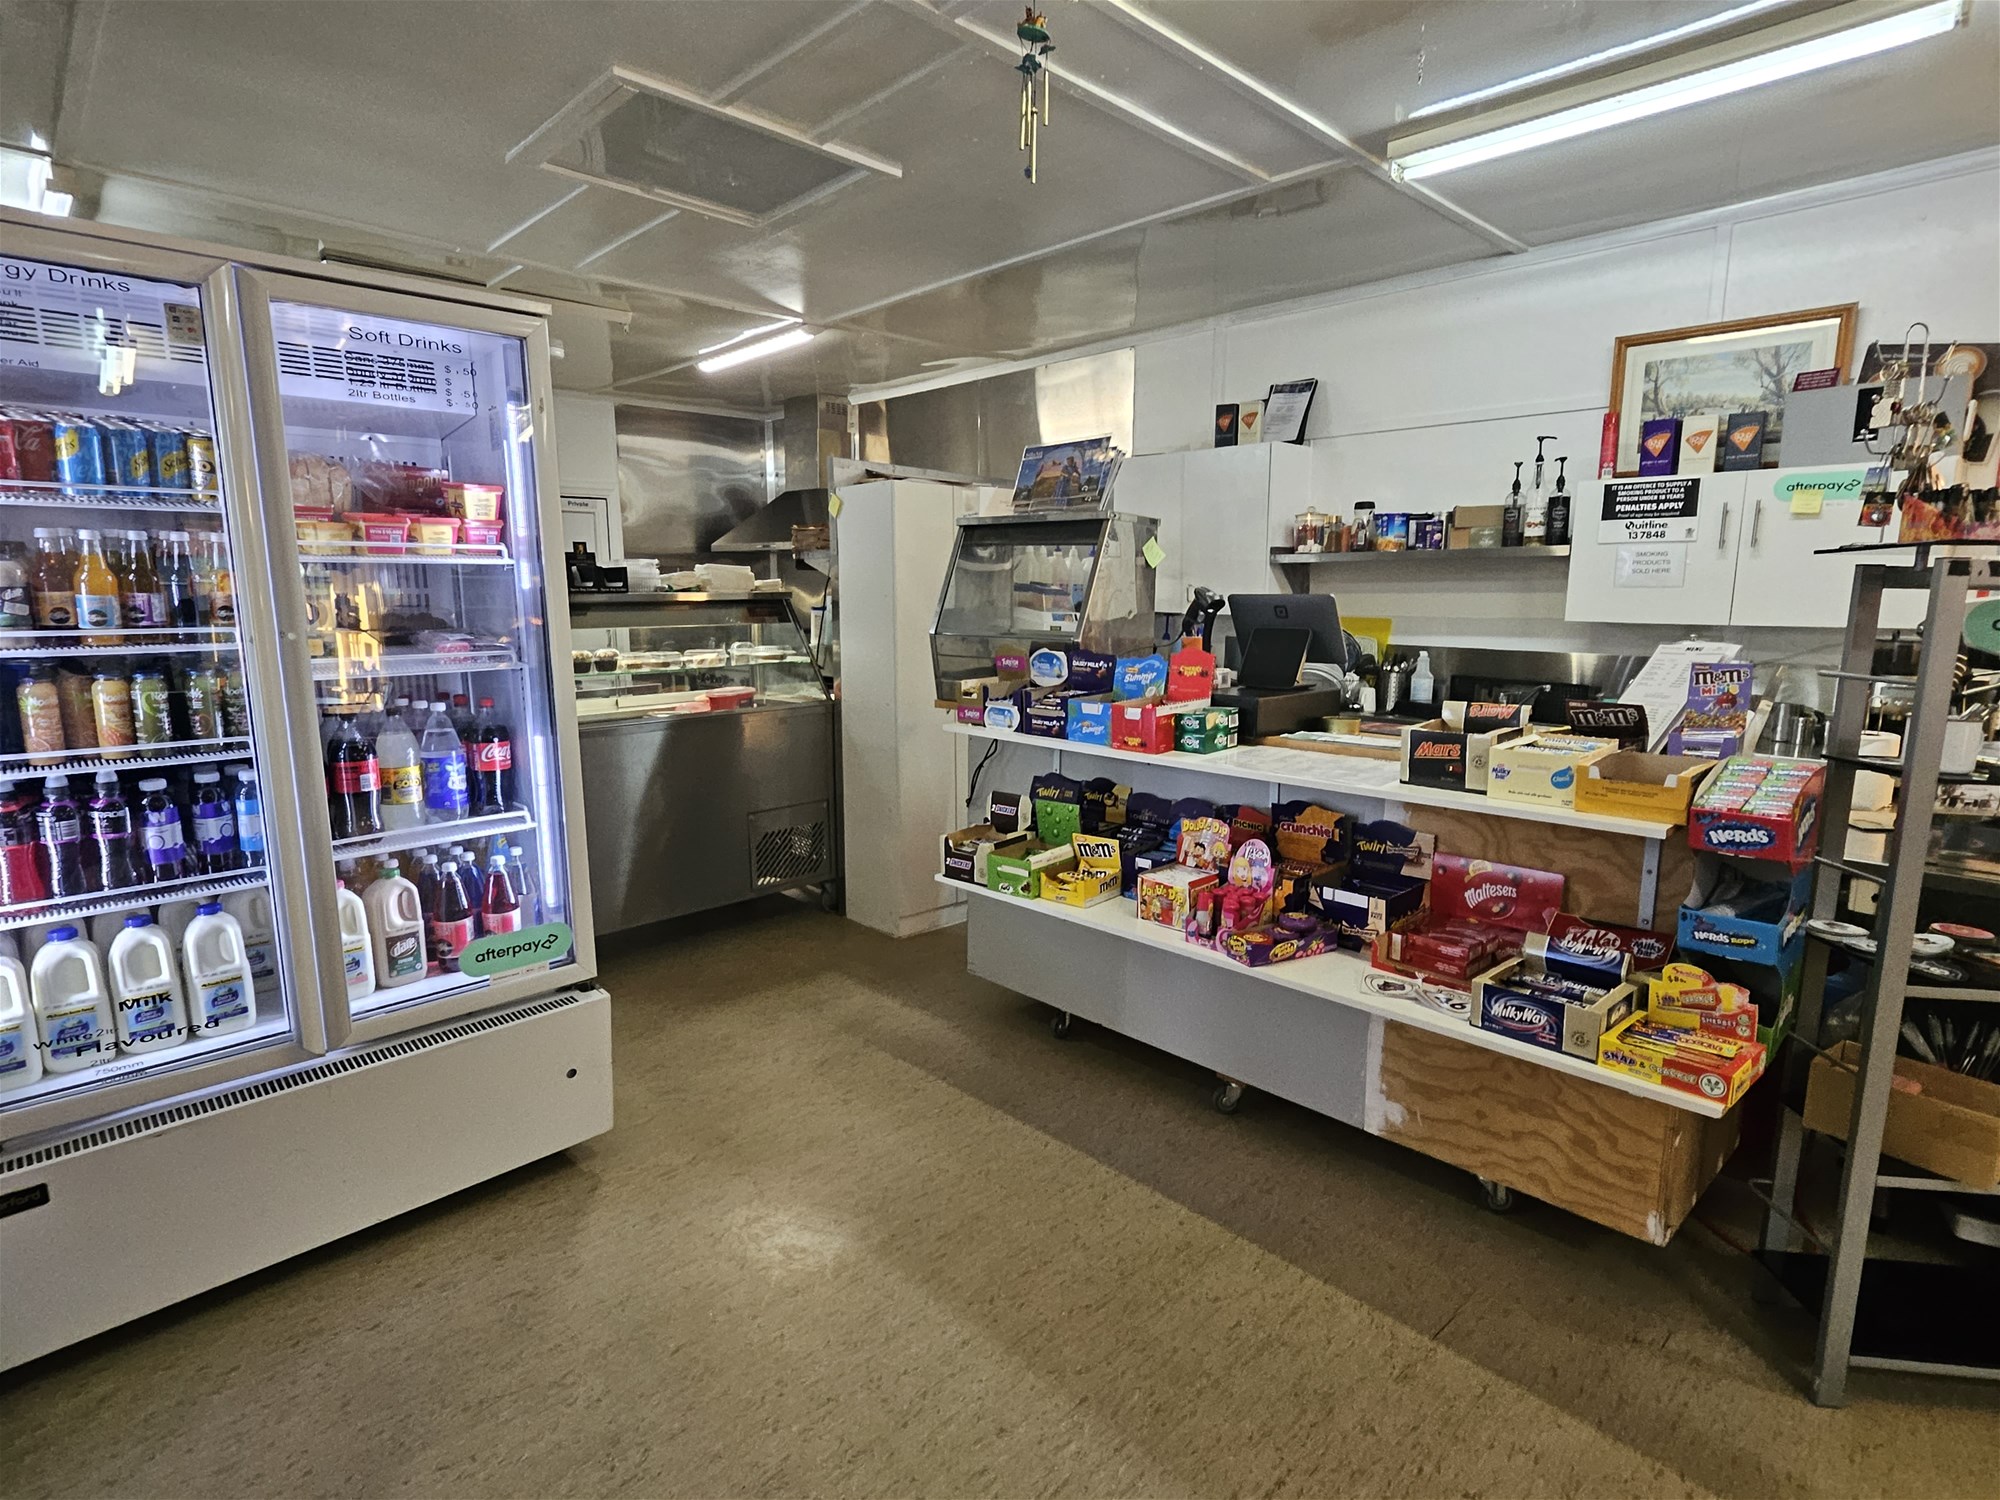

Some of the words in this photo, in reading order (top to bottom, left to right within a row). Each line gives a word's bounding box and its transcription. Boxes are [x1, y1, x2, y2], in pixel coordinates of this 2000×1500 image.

[0, 262, 37, 281] gy
[48, 267, 131, 293] Drinks
[348, 326, 390, 345] Soft
[398, 333, 463, 354] Drinks
[17, 358, 40, 369] Aid
[372, 391, 416, 403] Bottles
[1633, 482, 1657, 490] OFFENCE
[1665, 480, 1687, 488] SUPPLY
[1644, 487, 1671, 495] PRODUCT
[1786, 480, 1845, 492] afterpay
[1615, 502, 1657, 513] PENALTIES
[1658, 501, 1685, 510] APPLY
[1625, 520, 1668, 530] Quitline
[1628, 531, 1638, 540] 13
[1640, 530, 1666, 539] 7848
[1635, 550, 1669, 558] SMOKING
[1123, 671, 1157, 684] Summer
[1468, 703, 1520, 720] Mars
[1413, 741, 1462, 758] Mars
[1491, 767, 1511, 776] Milky
[1035, 787, 1061, 799] Twirl
[1084, 791, 1103, 803] Twirl
[996, 804, 1017, 815] SNICKERS
[1182, 818, 1212, 832] Double
[1212, 822, 1229, 838] Dip
[1233, 819, 1263, 832] PICNIC
[1279, 821, 1333, 839] crunchie
[1356, 839, 1386, 854] Twirl
[950, 858, 972, 870] SNICKERS
[1463, 882, 1518, 909] Maltesers
[474, 939, 542, 964] afterpay
[1633, 939, 1662, 953] Milky
[1636, 948, 1655, 957] bar
[118, 992, 174, 1013] Milk
[1701, 1016, 1737, 1028] SHERBET
[33, 1029, 94, 1050] White
[75, 1018, 221, 1057] Flavoured
[93, 1059, 144, 1077] 750mm
[1603, 1050, 1637, 1067] SNAP
[1638, 1060, 1646, 1069] &
[1649, 1063, 1698, 1086] CRACKLE
